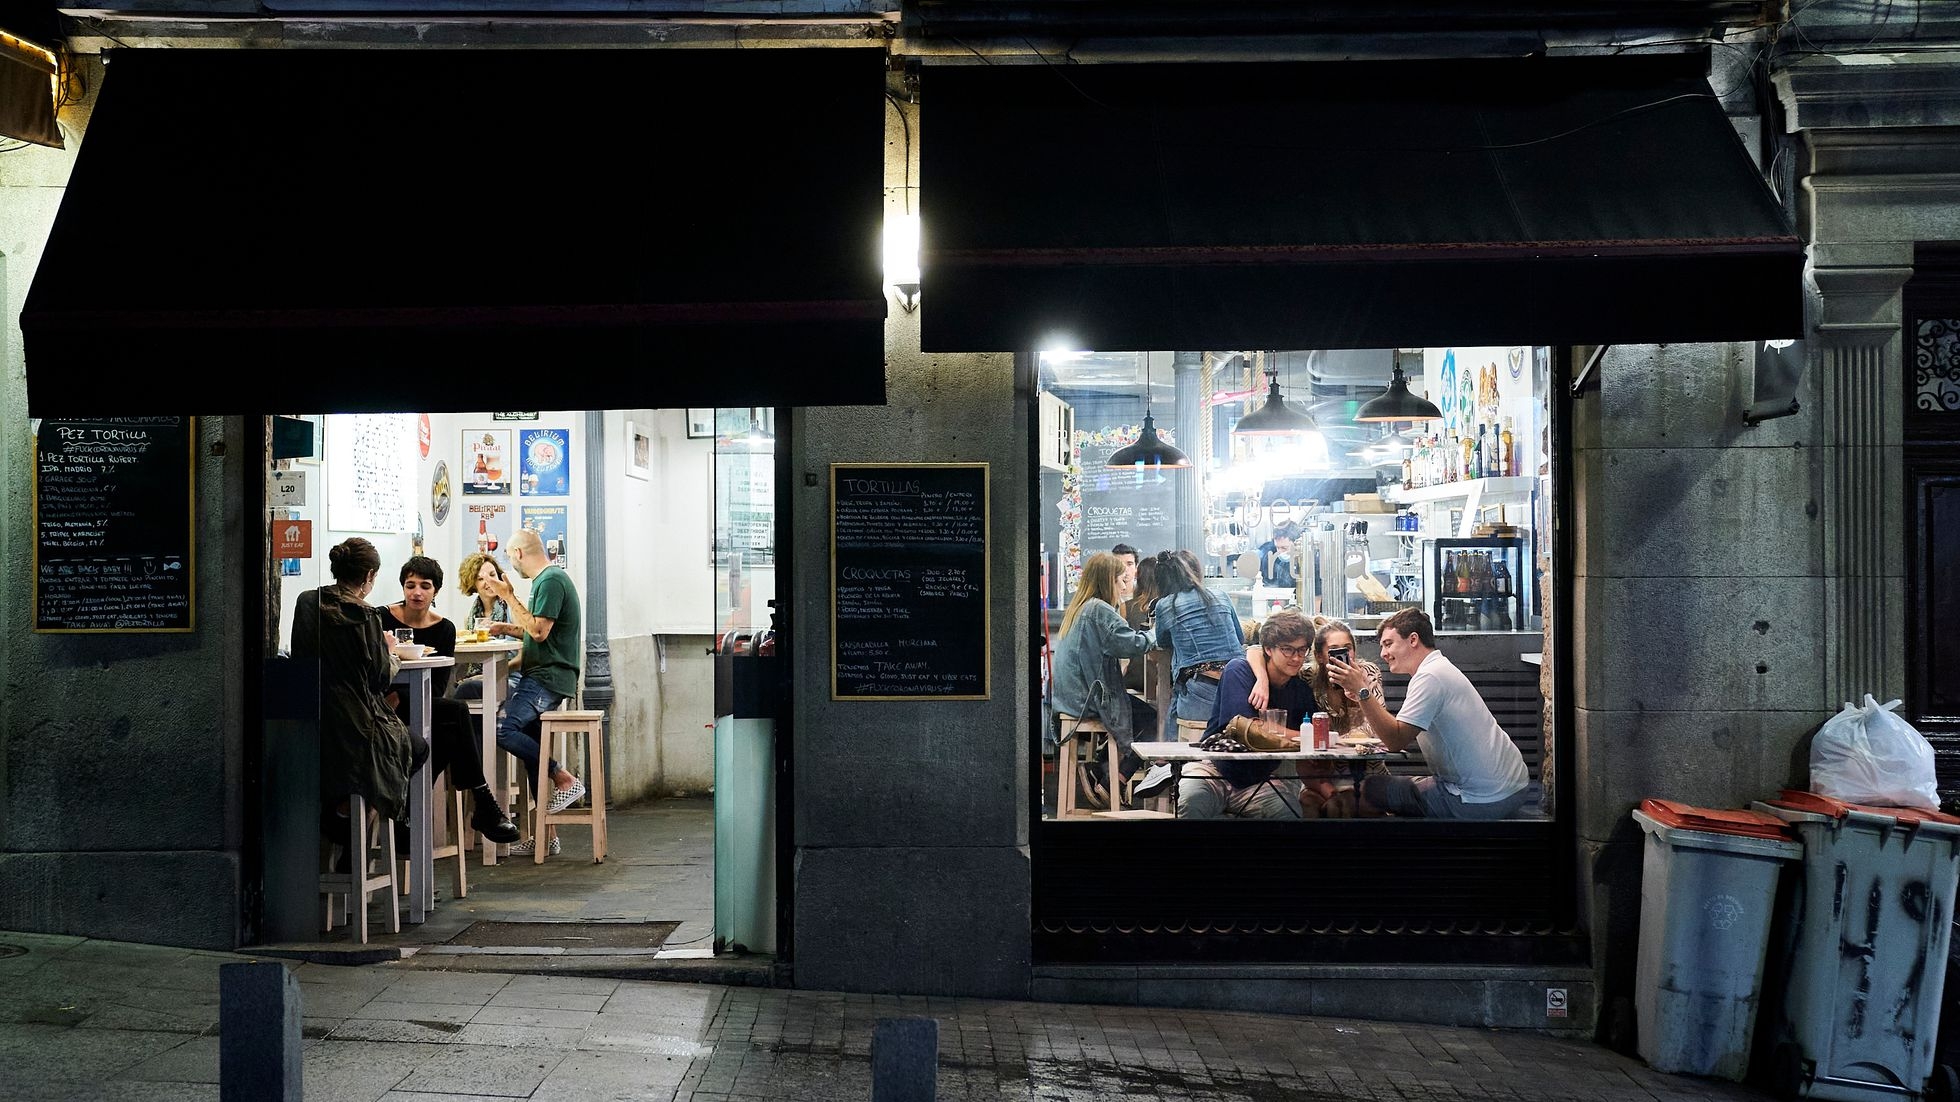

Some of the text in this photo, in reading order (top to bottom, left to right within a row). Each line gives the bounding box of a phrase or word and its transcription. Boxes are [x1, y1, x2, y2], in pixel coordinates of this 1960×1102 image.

[57, 427, 85, 440] PEZ
[524, 430, 565, 447] DELIRIUM
[47, 452, 65, 462] PEZ
[68, 455, 104, 463] TORTILLA
[65, 465, 92, 473] MADRID
[281, 485, 295, 493] L20
[842, 479, 920, 494] TORTILLAS
[469, 505, 506, 513] DELIRIUM
[1087, 507, 1132, 516] CROQUETAS
[1242, 498, 1319, 538] pez
[41, 564, 53, 573] WE
[58, 565, 74, 573] ARE
[78, 564, 100, 573] BACK
[103, 565, 121, 573] BABY
[842, 566, 912, 580] CROQUETAS
[840, 639, 938, 649] ENSALADILLA MURCIANA
[873, 661, 902, 672] TAKE
